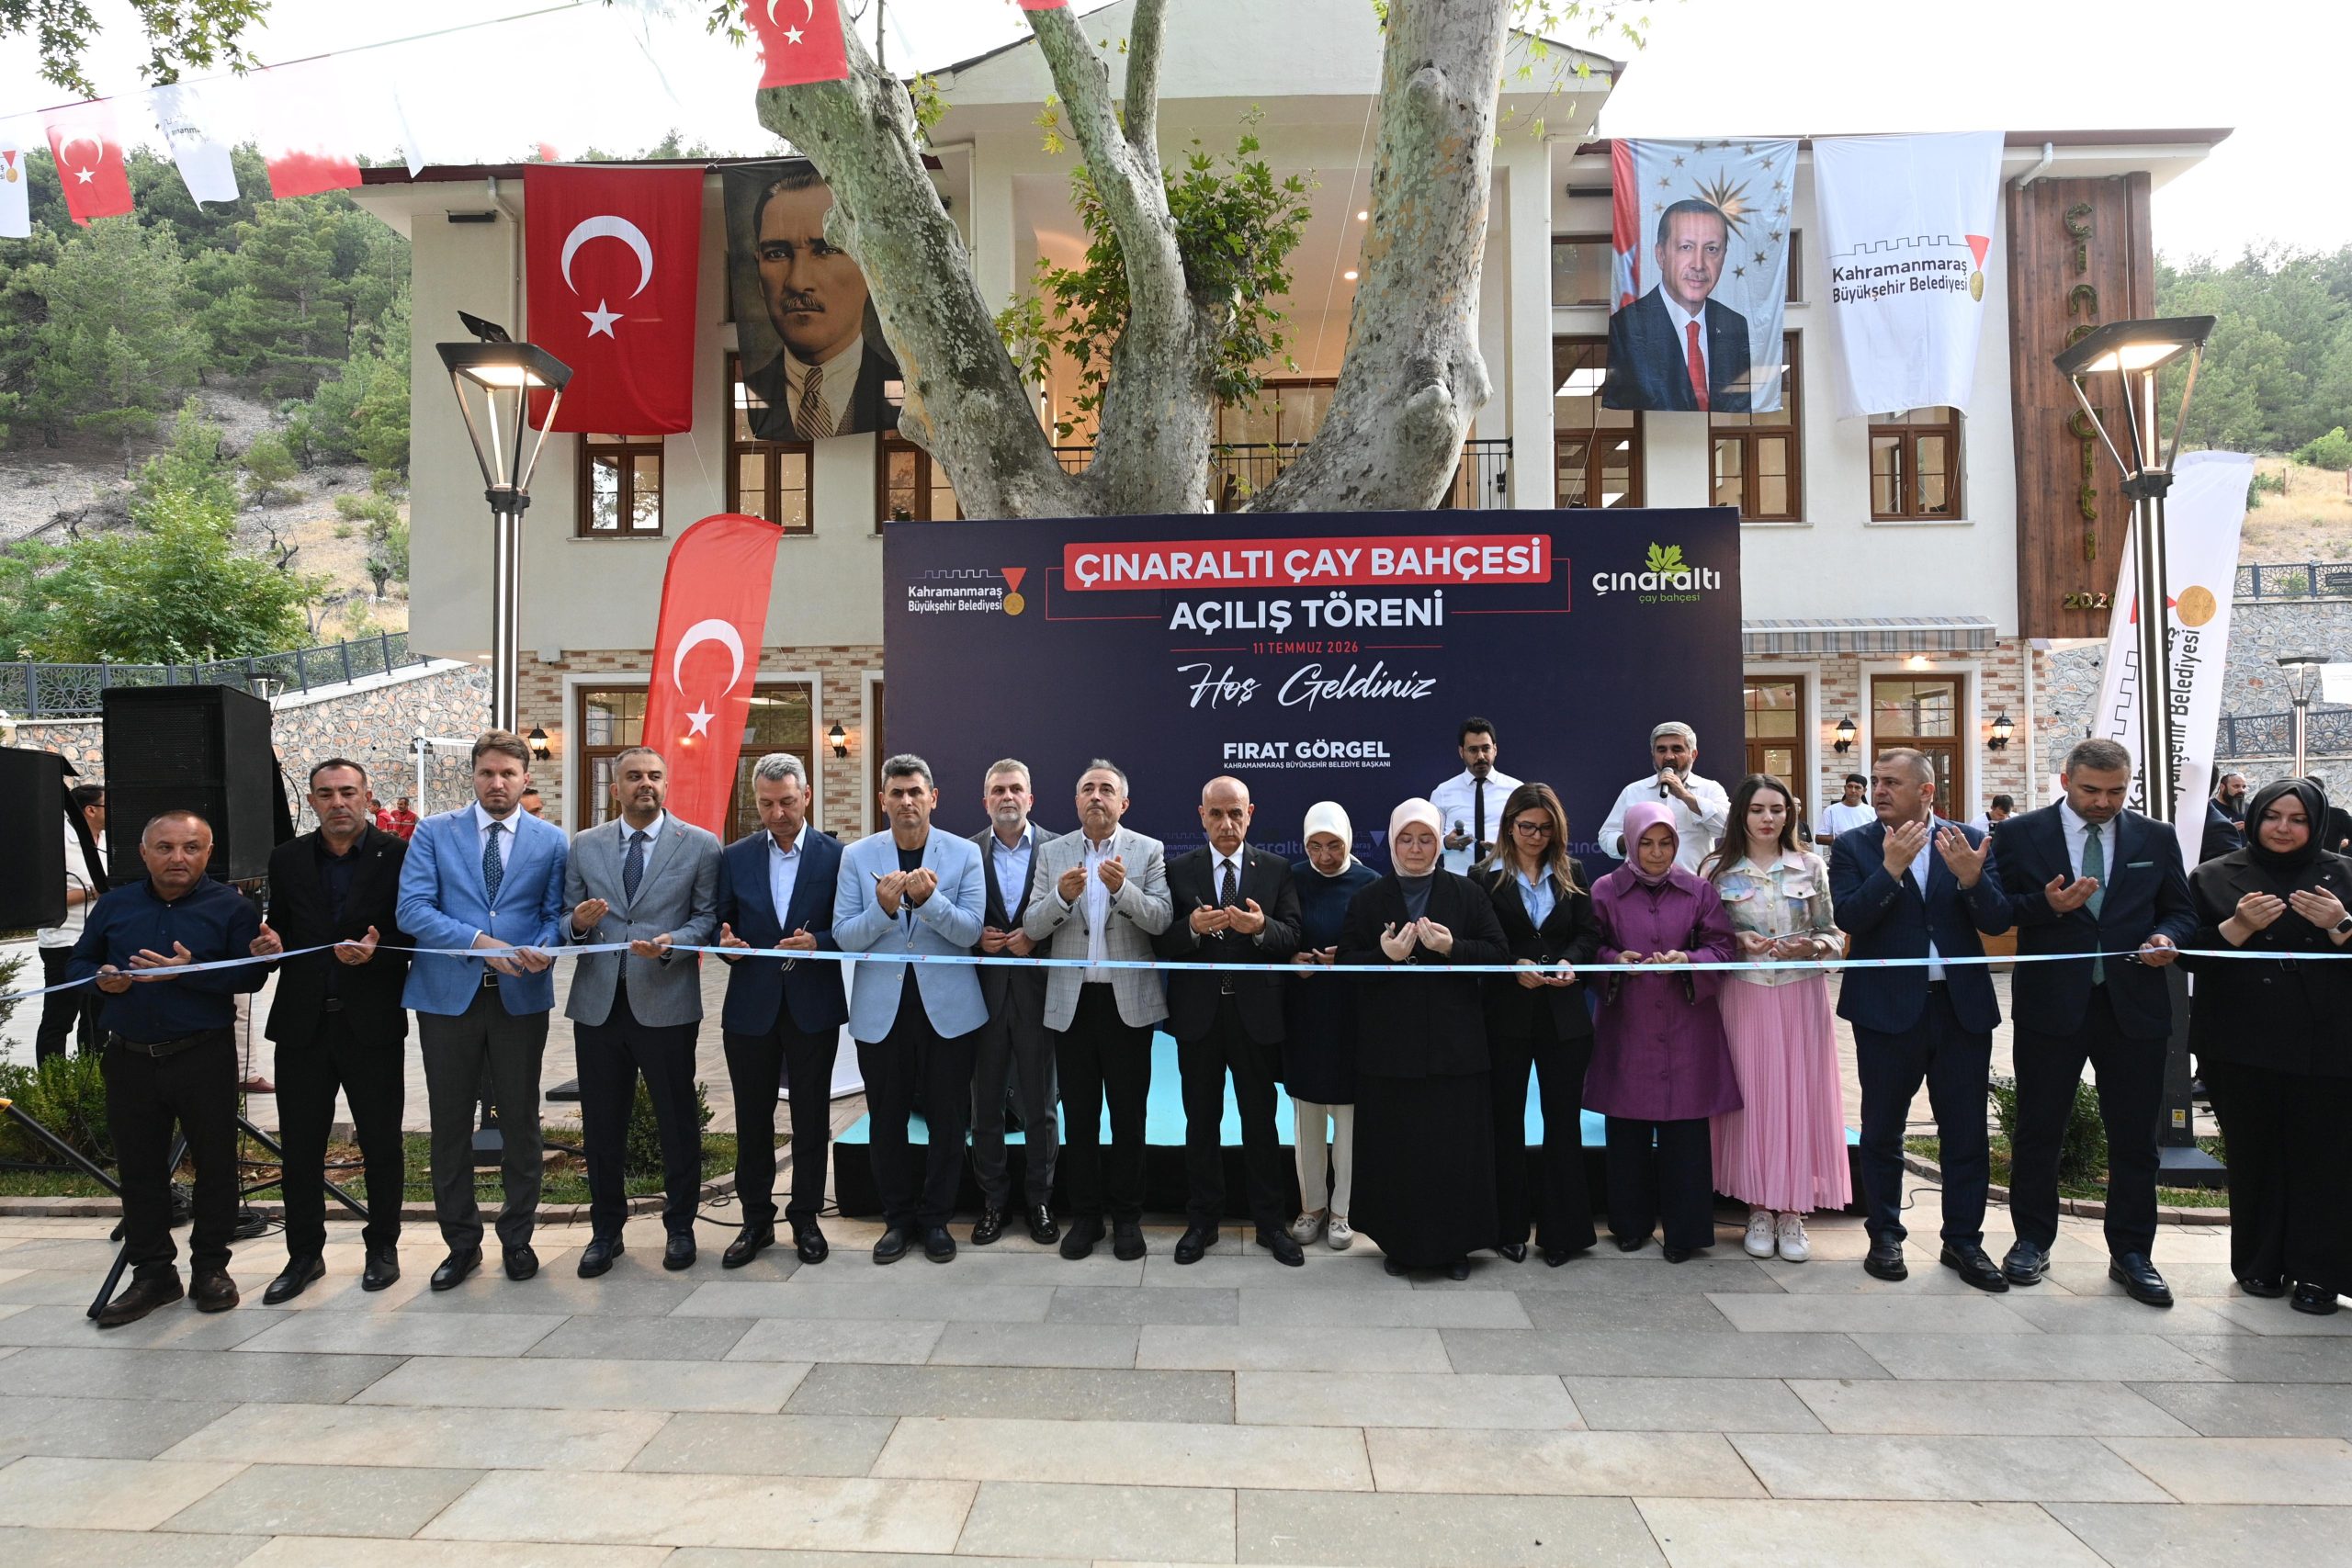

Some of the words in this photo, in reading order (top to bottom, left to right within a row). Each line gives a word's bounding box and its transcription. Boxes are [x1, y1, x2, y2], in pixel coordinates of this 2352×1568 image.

[1833, 259, 1967, 283] Kahramanmaraş
[1833, 279, 1905, 304] Büyükşehir
[1909, 275, 1968, 294] Belediyesi
[1074, 550, 1273, 588] ÇINARALTI
[1283, 547, 1362, 583] ÇAY
[1371, 536, 1541, 581] BAHÇESİ
[908, 585, 1002, 599] Kahramanmaraş
[1592, 567, 1721, 596] çınaraltı
[908, 600, 956, 615] Büyükşehir
[958, 598, 1002, 613] Belediyesi
[1639, 593, 1657, 604] çay
[1660, 592, 1701, 604] bahçesi
[1169, 599, 1293, 635] AÇILIŞ
[1301, 589, 1443, 628] TÖRENİ
[1252, 642, 1264, 655] 11
[1269, 641, 1322, 654] TEMMUZ
[1328, 640, 1359, 653] 2026
[2170, 629, 2202, 716] Belediyesi
[1177, 662, 1261, 710] Hoş
[1277, 660, 1437, 712] Geldiniz
[1223, 741, 1289, 760] FIRAT
[1295, 739, 1391, 760] GÖRGEL
[1224, 761, 1283, 770] KAHRAMANMARAŞ
[1285, 760, 1327, 770] BÜYÜKŞEHİR
[1329, 760, 1360, 768] BELEDİYE
[1362, 761, 1391, 769] BAŞKANI
